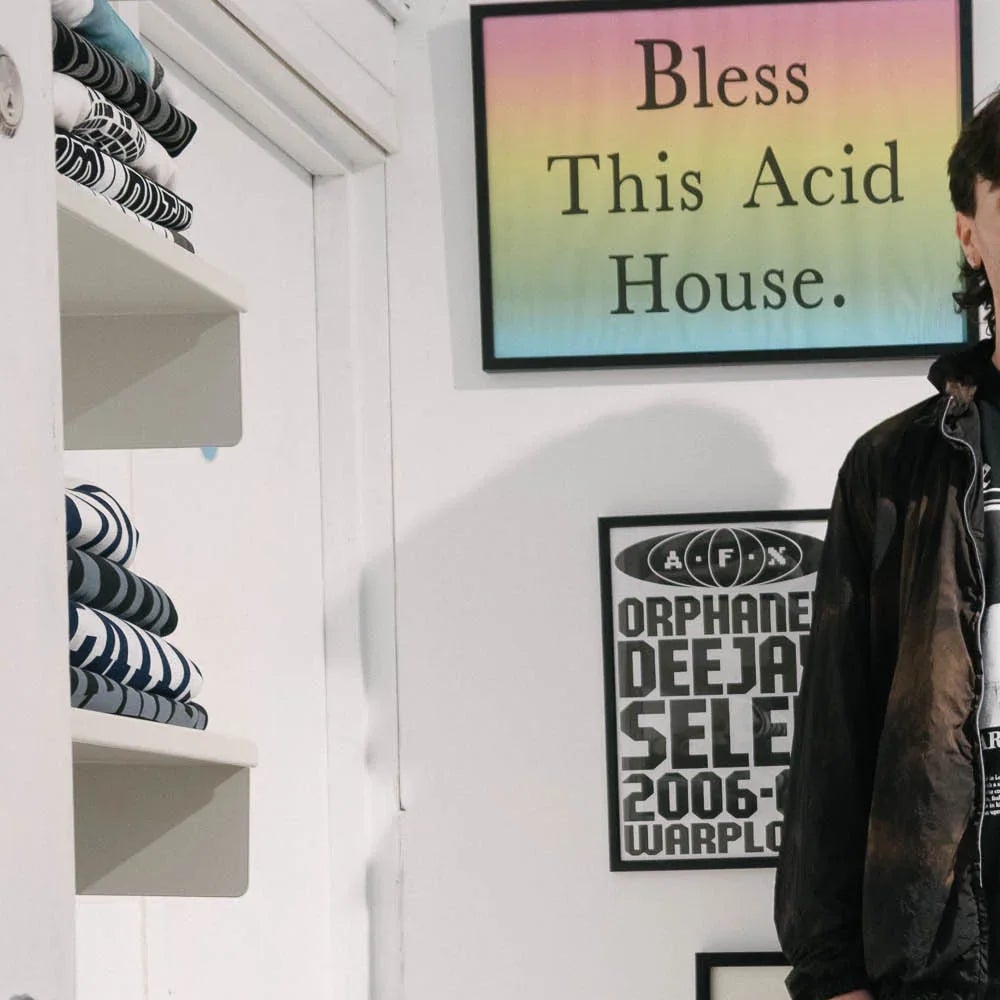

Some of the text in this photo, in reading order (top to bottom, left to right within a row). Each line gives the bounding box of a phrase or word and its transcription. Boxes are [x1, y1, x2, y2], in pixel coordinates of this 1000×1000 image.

[633, 37, 810, 111] Bless
[546, 139, 905, 216] This Acid
[608, 252, 847, 315] House.
[617, 591, 816, 637] ORPHANE
[617, 635, 803, 698] DEEJA
[620, 696, 793, 771] SELE
